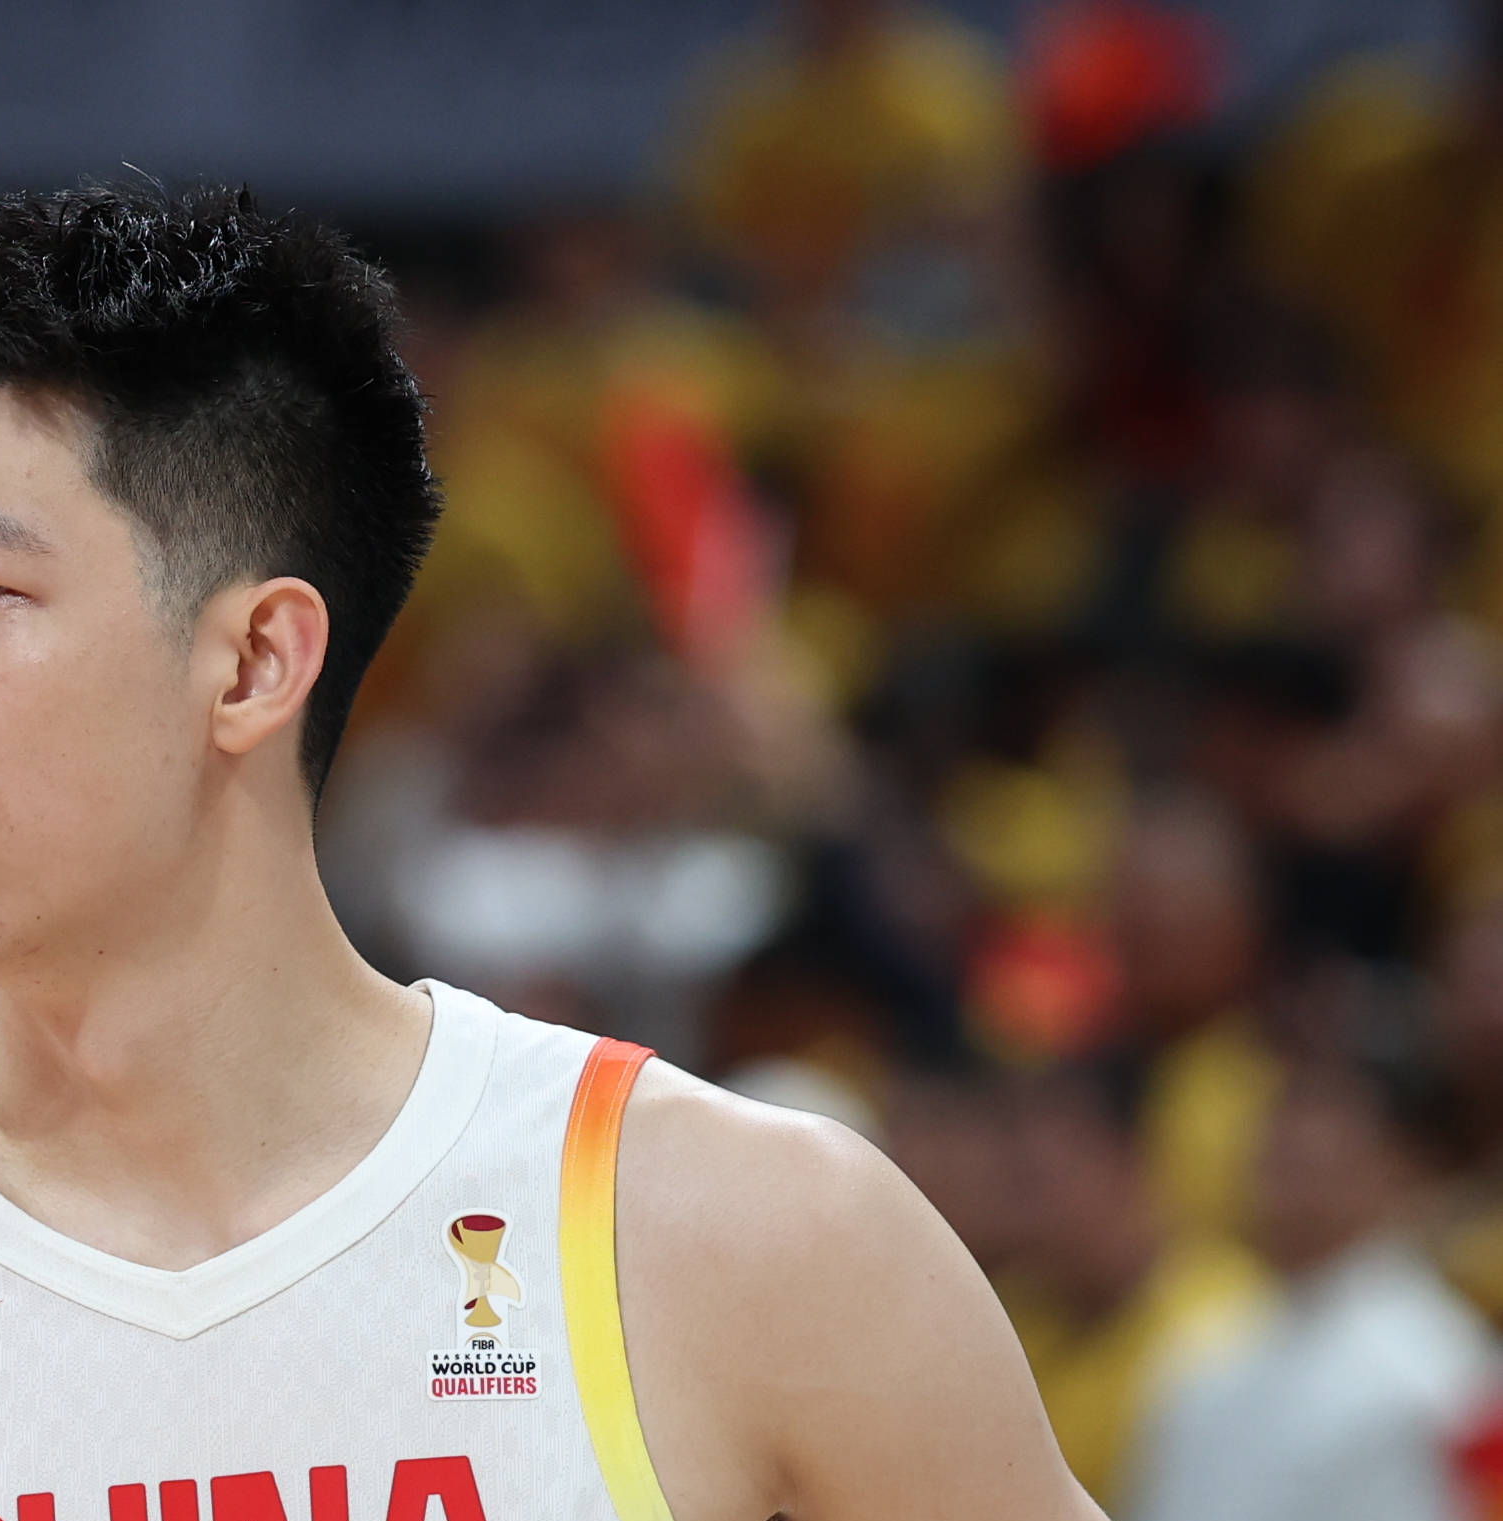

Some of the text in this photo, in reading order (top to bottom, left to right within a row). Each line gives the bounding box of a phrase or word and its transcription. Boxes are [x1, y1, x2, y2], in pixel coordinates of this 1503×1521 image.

[472, 1340, 495, 1350] FIBA
[432, 1361, 536, 1375] WORLD CUP
[431, 1377, 537, 1398] QUALIFIERS
